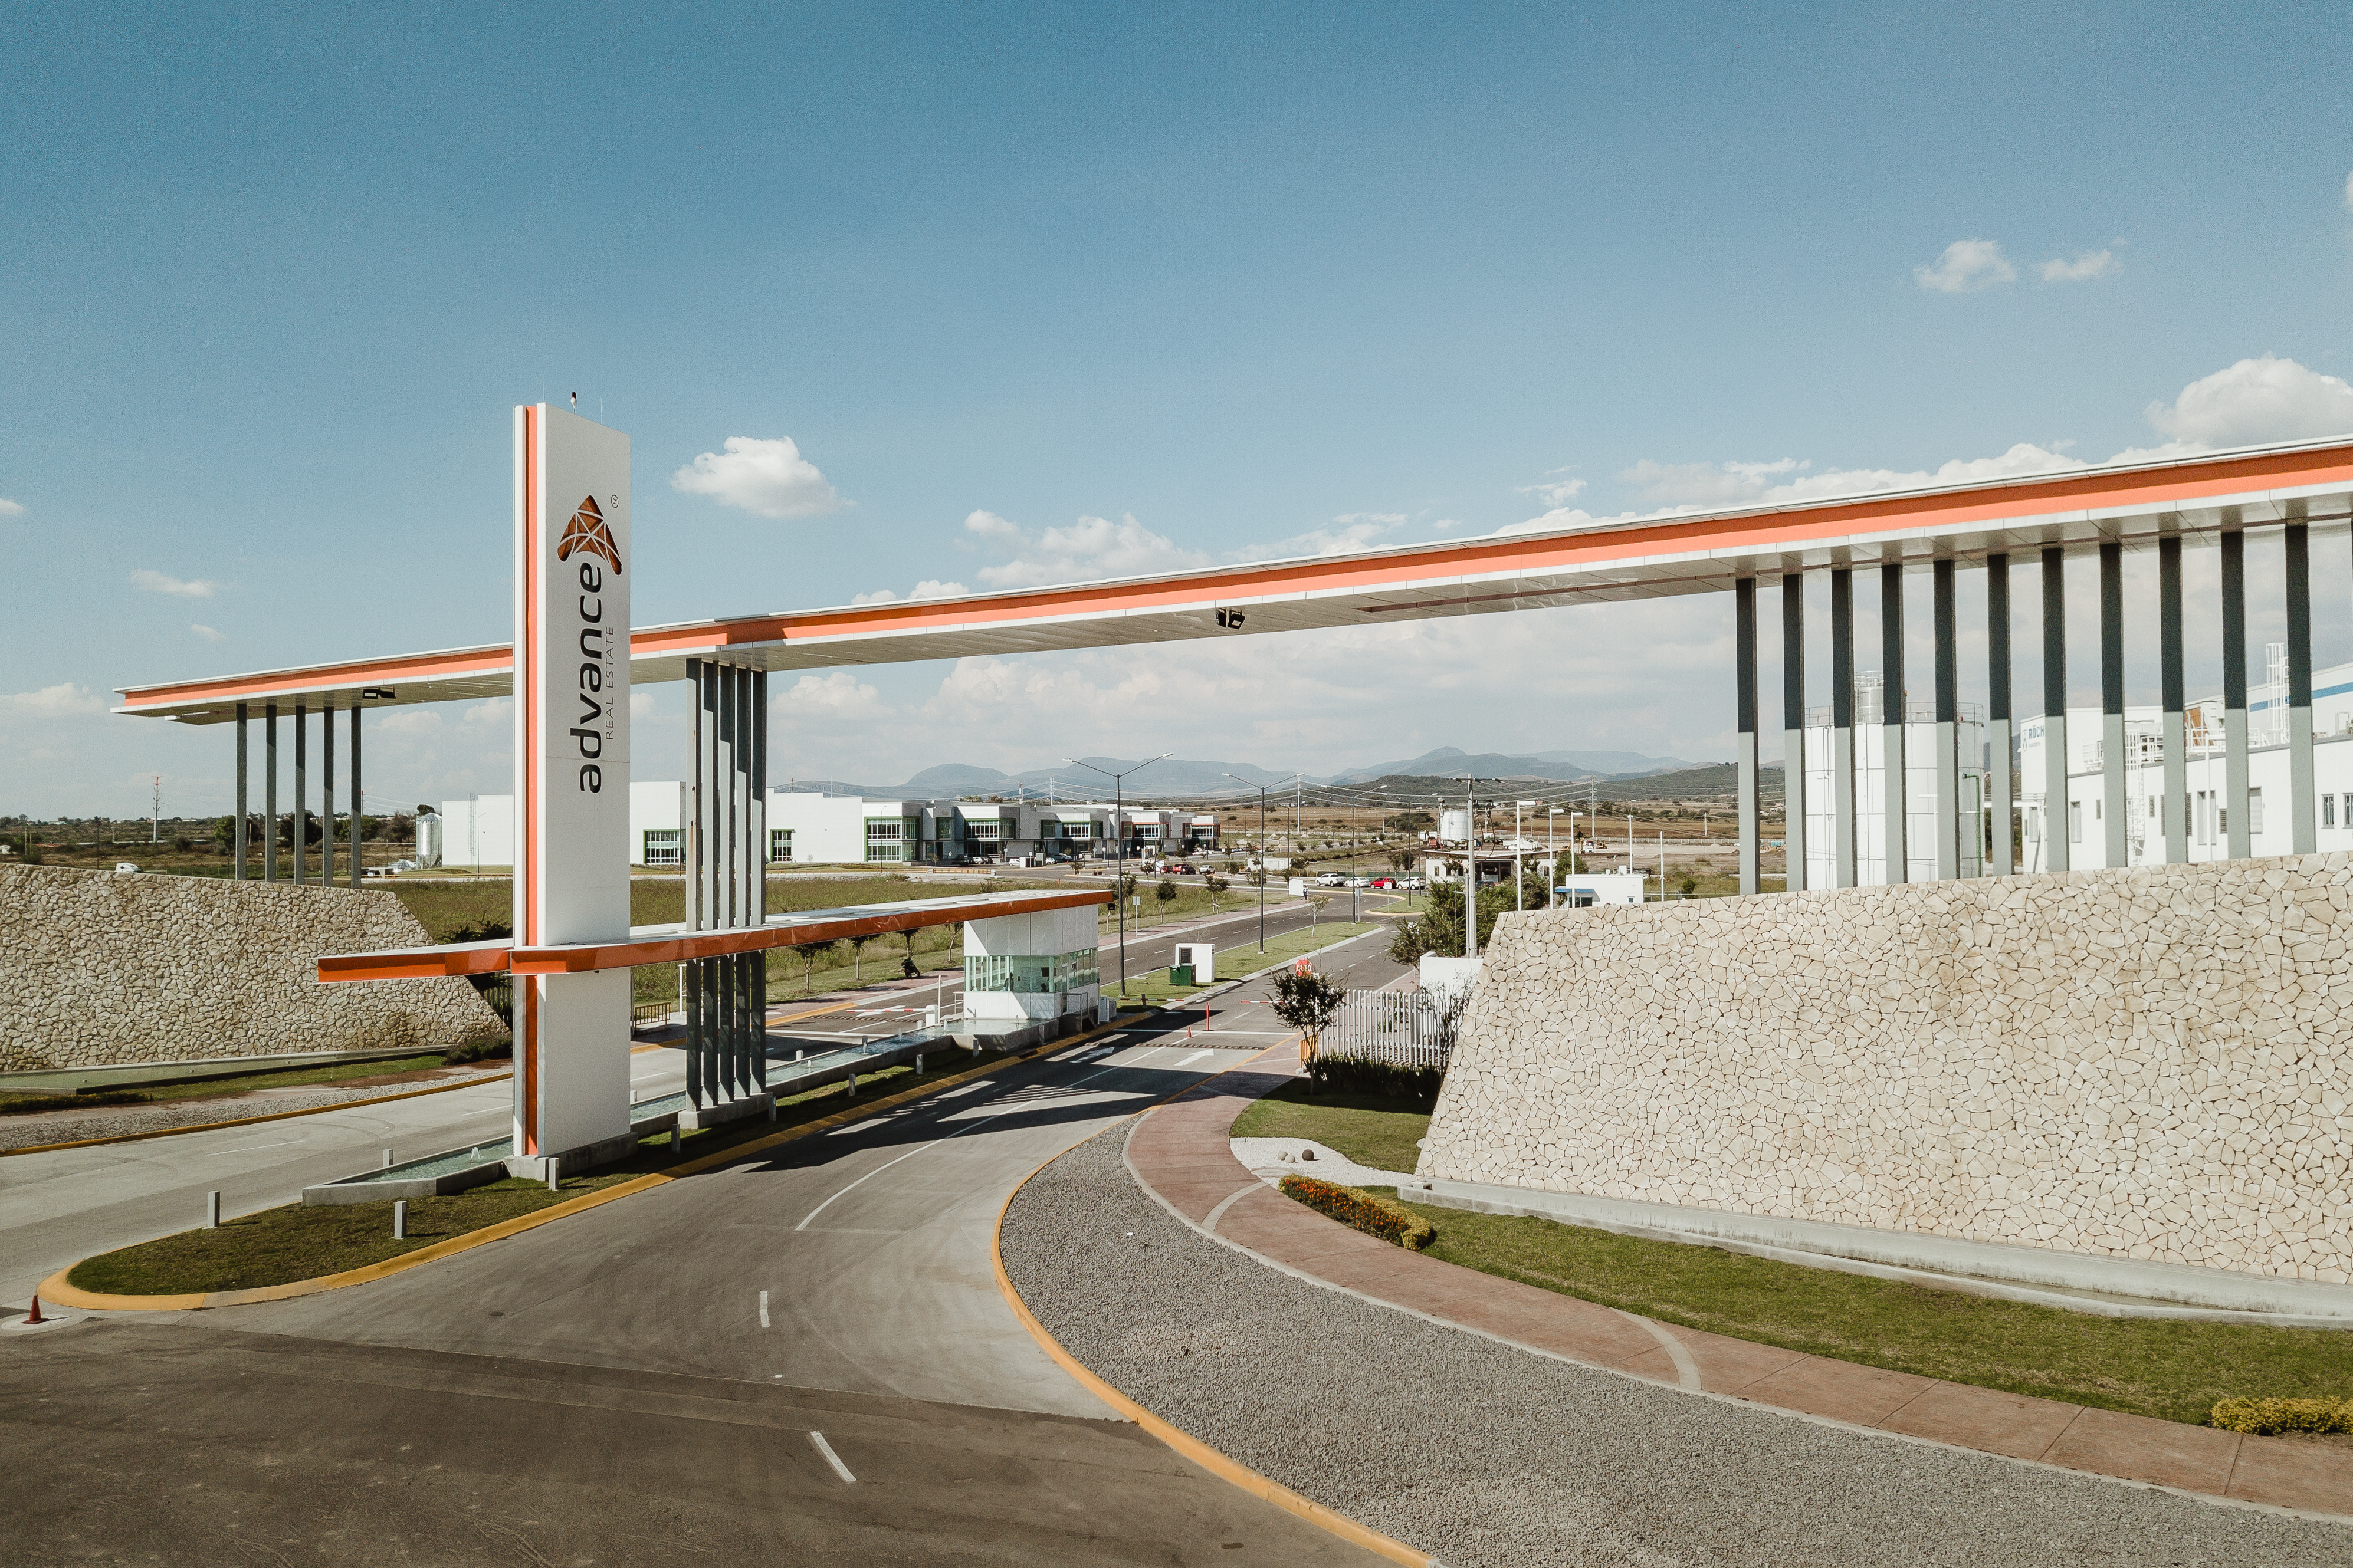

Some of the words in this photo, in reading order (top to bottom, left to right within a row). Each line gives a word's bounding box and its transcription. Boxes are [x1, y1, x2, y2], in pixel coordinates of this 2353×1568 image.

[570, 562, 602, 793] advance
[605, 626, 614, 689] ESTATE
[605, 696, 614, 739] REAL
[1296, 964, 1312, 972] ALTO
